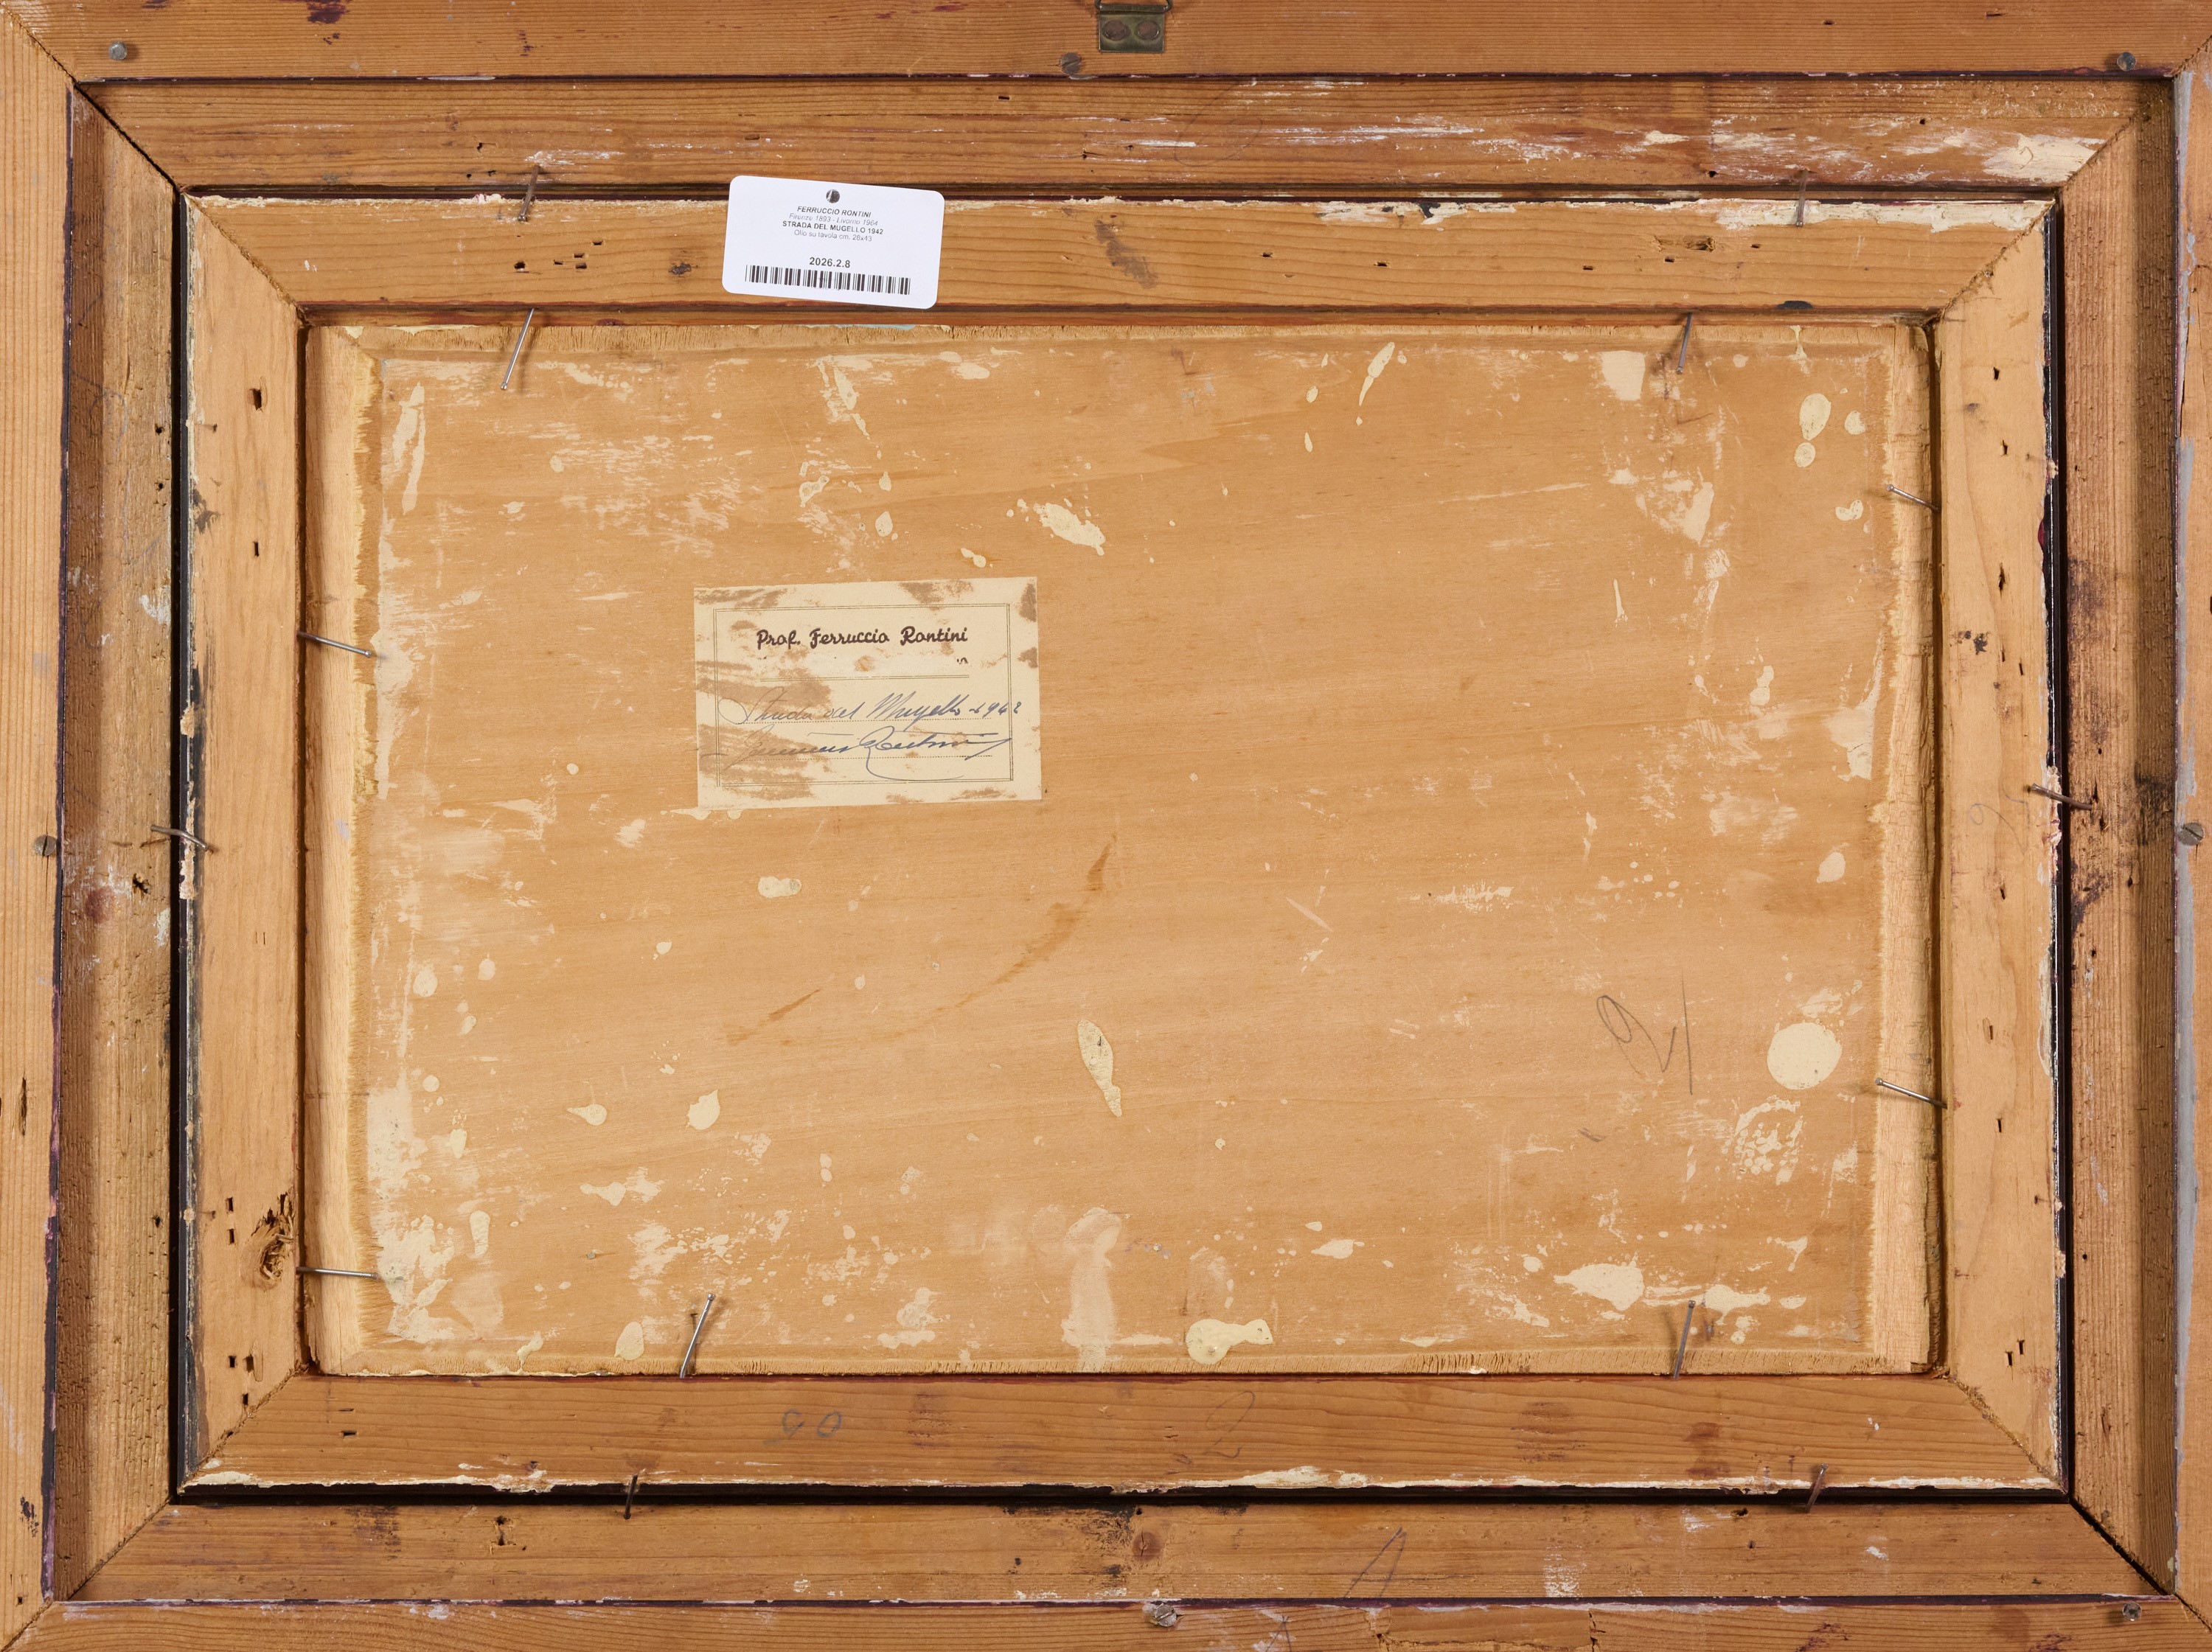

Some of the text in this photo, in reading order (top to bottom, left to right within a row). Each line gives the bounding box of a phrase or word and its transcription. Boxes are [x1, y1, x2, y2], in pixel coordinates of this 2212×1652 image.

[796, 206, 872, 218] FERRUCCIO RONTINI
[789, 212, 813, 222] Firenze
[836, 217, 860, 226] Livorno
[782, 220, 812, 229] STRADA
[830, 224, 866, 234] MUGELLO
[794, 229, 807, 237] Olio
[818, 231, 838, 240] tavola
[852, 234, 872, 242] 28x43
[809, 257, 851, 268] 2026.2.8
[757, 625, 968, 649] Prof. Ferruccio Rontini
